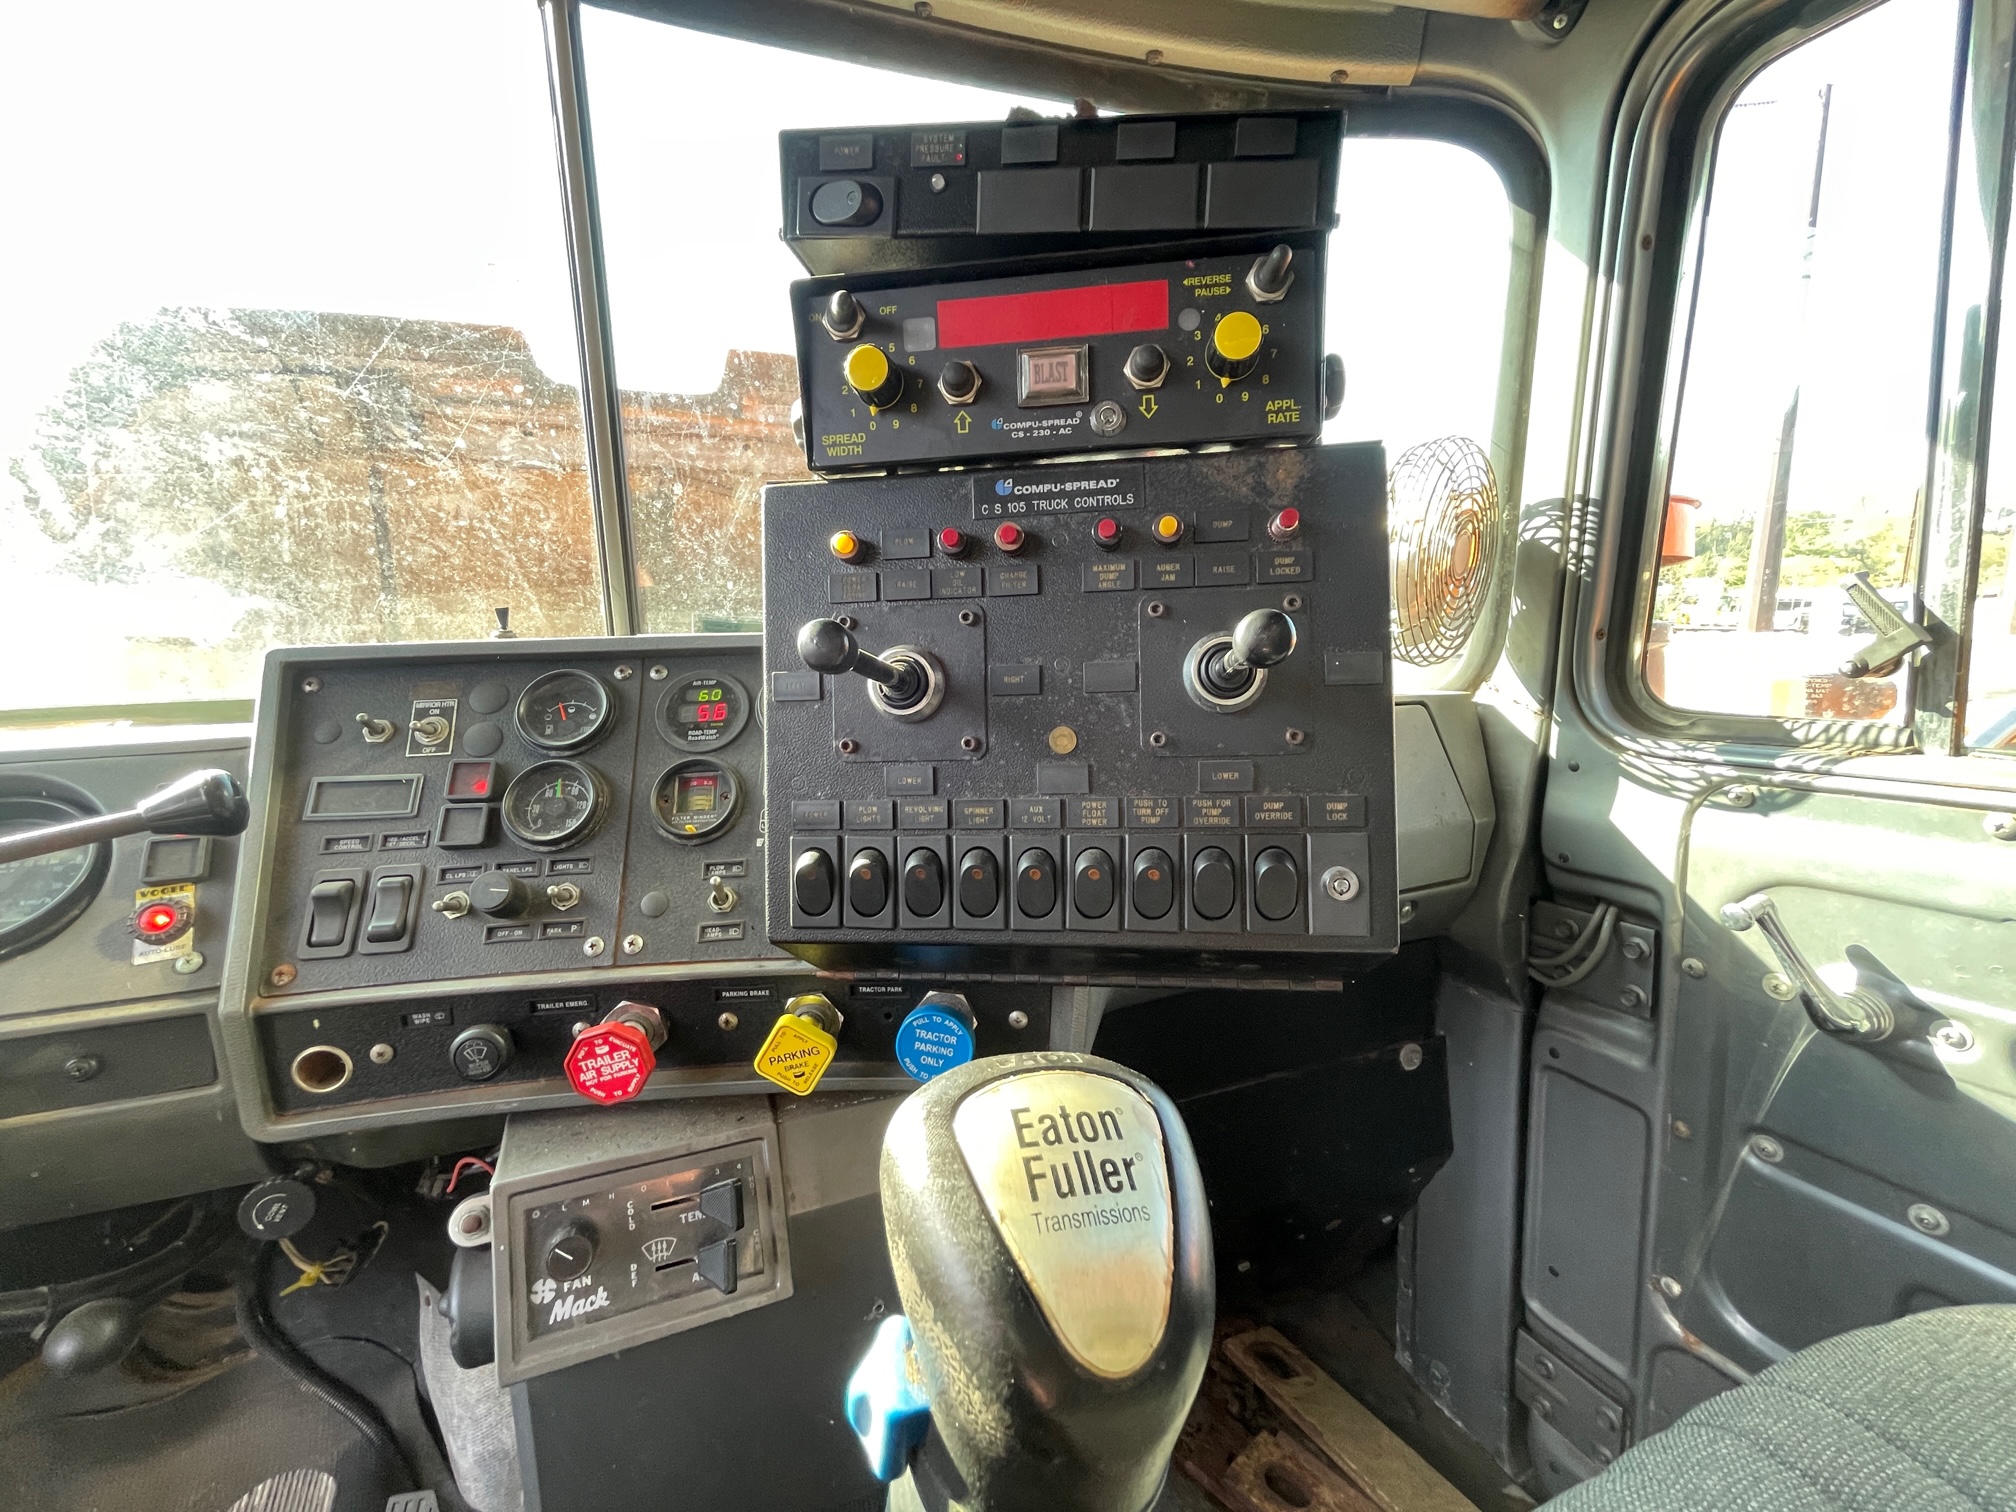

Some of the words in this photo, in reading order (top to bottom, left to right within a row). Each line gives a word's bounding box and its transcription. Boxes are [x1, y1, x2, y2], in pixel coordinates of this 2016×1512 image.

[922, 134, 955, 143] SYSTEM
[915, 143, 955, 153] PRESSURE
[921, 153, 946, 163] FAULT
[1188, 273, 1232, 286] REVERSE
[1195, 285, 1226, 298] PAUSE
[879, 305, 898, 316] OFF
[1262, 324, 1270, 335] 6
[1194, 330, 1202, 341] 3
[888, 342, 896, 353] 5
[1271, 348, 1278, 359] 7
[908, 355, 916, 366] 6
[1186, 356, 1194, 367] 2
[1033, 360, 1069, 386] BLAST
[917, 379, 924, 389] 7
[1195, 379, 1201, 390] 1
[1262, 374, 1270, 385] 8
[841, 385, 849, 395] 2
[1215, 393, 1224, 404] 0
[1241, 391, 1249, 402] 9
[910, 403, 918, 413] 8
[1265, 399, 1302, 412] APPL.
[850, 408, 856, 418] 1
[1267, 411, 1301, 424] RATE
[869, 420, 877, 431] 0
[892, 419, 900, 430] 9
[1003, 417, 1081, 430] COMPU-SPREAD
[1011, 431, 1025, 439] CS
[1032, 428, 1051, 437] 230
[1058, 427, 1073, 435] AC
[821, 432, 867, 446] SPREAD
[826, 445, 862, 457] WIDTH
[1013, 479, 1118, 495] COMPU-SPREAD
[981, 504, 989, 515] C
[994, 503, 1002, 514] S
[1007, 501, 1026, 513] 105
[1032, 498, 1069, 511] TRUCK
[1074, 493, 1135, 508] CONTROLS
[1212, 520, 1233, 529] DUMP
[894, 537, 915, 546] PLOW
[1274, 556, 1295, 565] DUMP
[1092, 563, 1126, 572] MAXIMUM
[1156, 562, 1181, 572] AUGER
[1212, 565, 1236, 574] RAISE
[1269, 566, 1301, 576] LOCKED
[950, 570, 965, 579] LOW
[999, 571, 1028, 580] CHANGE
[1099, 572, 1119, 580] DUMP
[1160, 573, 1176, 582] JAM
[952, 578, 964, 587] OIL
[1001, 580, 1027, 590] FILTER
[1098, 580, 1121, 589] ANGLE
[939, 586, 977, 596] INDICATOR
[1003, 675, 1025, 684] RIGHT
[699, 689, 722, 702] 60
[415, 701, 441, 709] MIRROR
[441, 700, 455, 708] HTR
[697, 703, 727, 722] 56
[422, 746, 437, 754] OFF
[898, 776, 922, 786] LOWER
[1212, 771, 1239, 781] LOWER
[576, 801, 587, 810] 120
[1081, 801, 1107, 810] POWER
[1133, 799, 1154, 808] PUSH
[1158, 799, 1168, 807] TO
[1192, 799, 1213, 808] PUSH
[1216, 799, 1232, 807] FOR
[1263, 802, 1285, 810] DUMP
[1326, 802, 1348, 811] DUMP
[531, 804, 540, 814] 30
[858, 805, 878, 814] PLOW
[904, 805, 944, 814] REVOLVING
[964, 806, 994, 815] SPINNER
[1029, 805, 1044, 813] AUX
[1082, 809, 1106, 818] FLOAT
[1132, 808, 1152, 816] TURN
[1155, 807, 1170, 815] OFF
[1201, 808, 1222, 816] PUMP
[856, 814, 881, 824] LIGHTS
[914, 814, 935, 823] LIGHT
[968, 816, 989, 825] LIGHT
[1021, 815, 1028, 824] 12
[1032, 815, 1051, 824] VOLT
[1140, 816, 1161, 825] PUMP
[1193, 817, 1231, 825] OVERRIDE
[1254, 812, 1293, 821] OVERRIDE
[1326, 812, 1348, 821] LOCK
[1081, 818, 1108, 826] POWER
[721, 990, 749, 998] PARKING
[537, 1002, 565, 1010] TRAILER
[565, 1000, 590, 1008] EMERG.
[411, 1012, 431, 1020] WASH
[912, 1017, 930, 1027] PULL
[932, 1015, 942, 1023] TO
[943, 1019, 964, 1036] APPLY
[771, 1041, 782, 1053] PULL
[779, 1031, 787, 1039] TO
[793, 1033, 809, 1044] APPLY
[915, 1029, 957, 1046] TRACTOR
[577, 1046, 589, 1060] PULL
[608, 1035, 637, 1053] EVACUATE
[914, 1041, 954, 1057] PARKING
[578, 1049, 632, 1072] TRAILER
[768, 1046, 821, 1066] PARKING
[784, 1061, 810, 1072] BRAKE
[920, 1055, 945, 1068] ONLY
[579, 1069, 598, 1082] AIR
[600, 1057, 639, 1075] SUPPLY
[903, 1057, 918, 1074] PUSH
[919, 1071, 929, 1080] TO
[585, 1078, 598, 1087] NOT
[599, 1074, 613, 1083] FOR
[613, 1068, 638, 1079] PARKING
[776, 1071, 791, 1082] PUSH
[792, 1079, 800, 1087] TO
[803, 1063, 819, 1084] RELEASE
[589, 1087, 607, 1098] PUSH
[613, 1089, 623, 1097] TO
[627, 1073, 641, 1093] SUPPLY
[1010, 1105, 1124, 1149] Eaton
[736, 1162, 742, 1170] 4
[1021, 1149, 1137, 1203] Fuller
[608, 1192, 615, 1200] H
[582, 1198, 590, 1207] M
[562, 1204, 568, 1212] L
[627, 1200, 636, 1231] COLD
[1031, 1202, 1152, 1236] Transmissions
[630, 1263, 638, 1288] DEF
[563, 1274, 592, 1293] FAN
[548, 1285, 611, 1325] Mack
